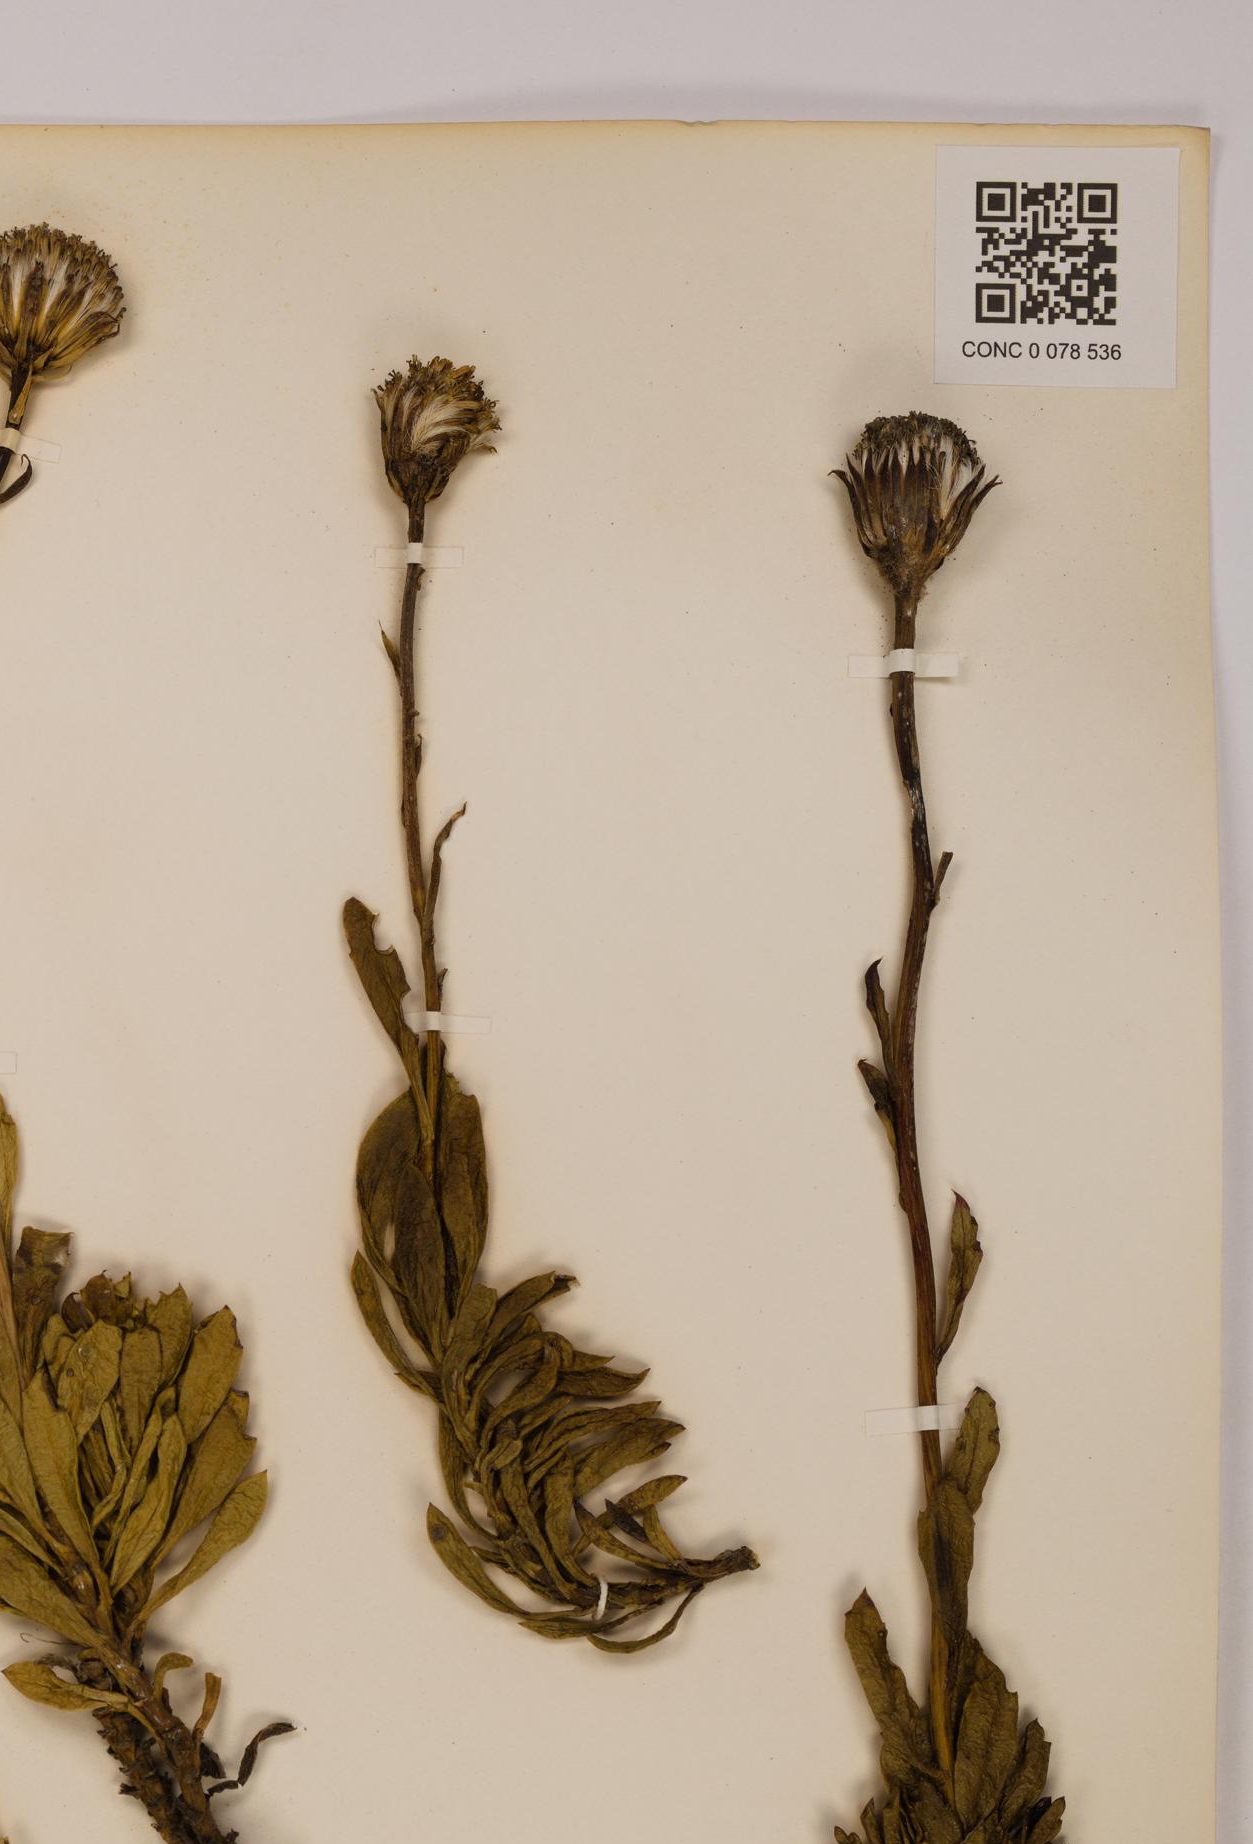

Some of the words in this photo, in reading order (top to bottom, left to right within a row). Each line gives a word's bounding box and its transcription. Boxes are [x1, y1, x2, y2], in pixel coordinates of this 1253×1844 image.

[961, 340, 1023, 359] CONC
[1028, 342, 1040, 360] 0
[1046, 342, 1081, 361] 078
[1087, 343, 1122, 361] 536
